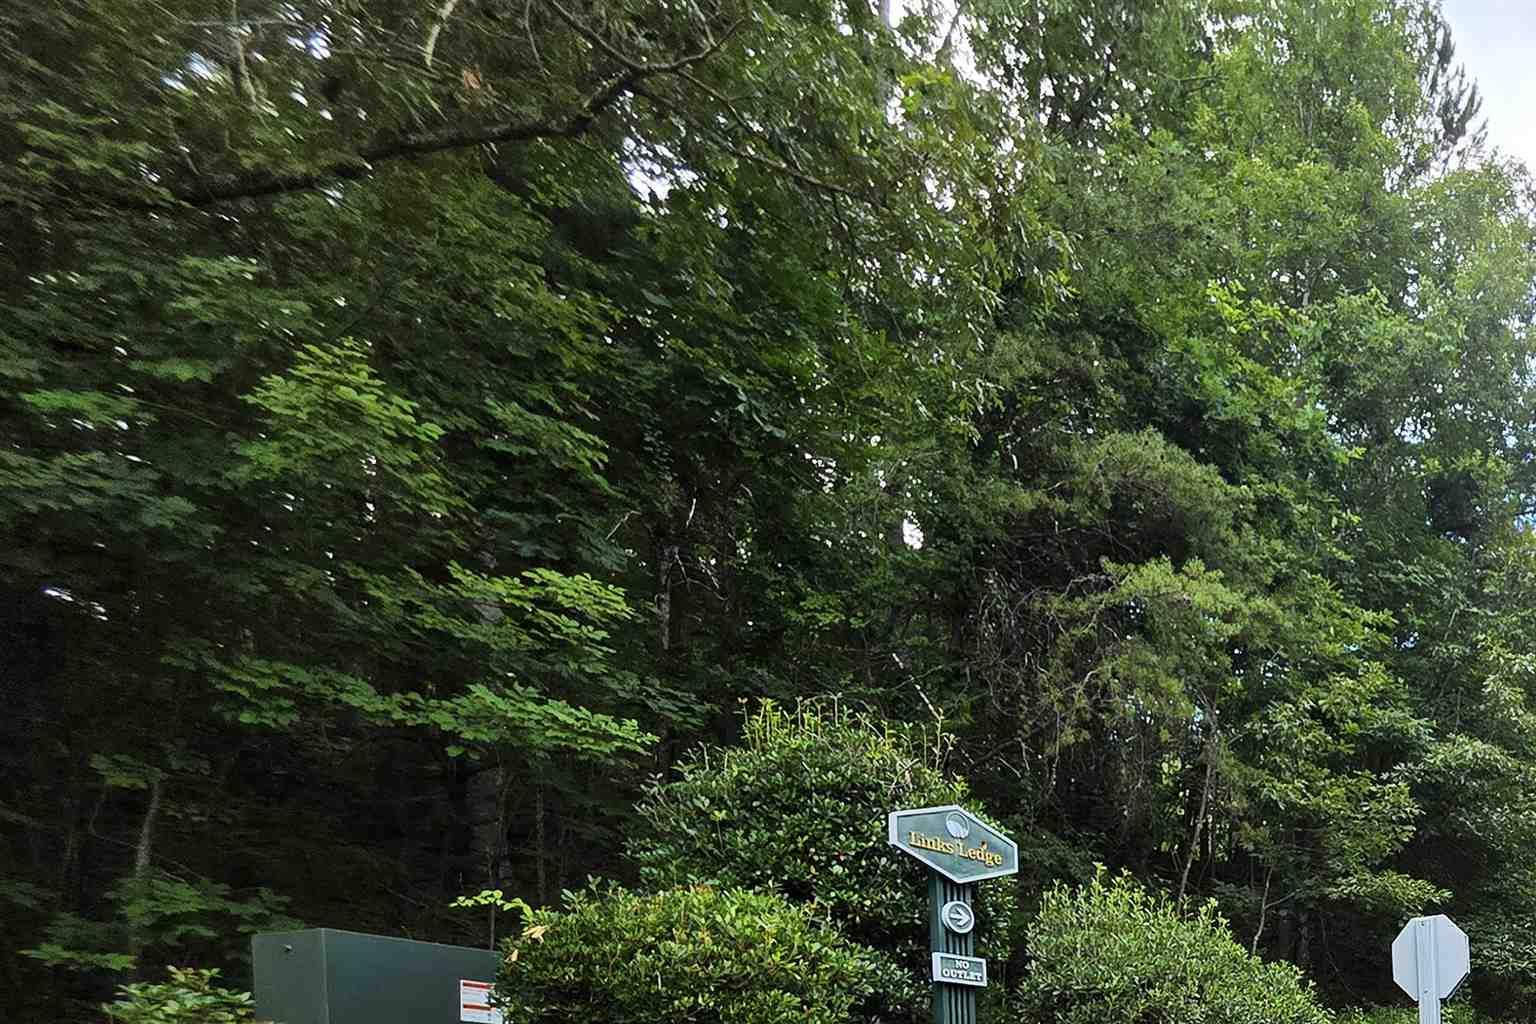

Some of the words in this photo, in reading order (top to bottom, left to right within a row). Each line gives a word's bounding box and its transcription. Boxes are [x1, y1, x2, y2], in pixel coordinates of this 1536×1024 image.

[909, 831, 954, 854] Links
[957, 840, 1003, 868] Ledge
[954, 959, 970, 969] NO
[943, 968, 982, 981] OUTLET
